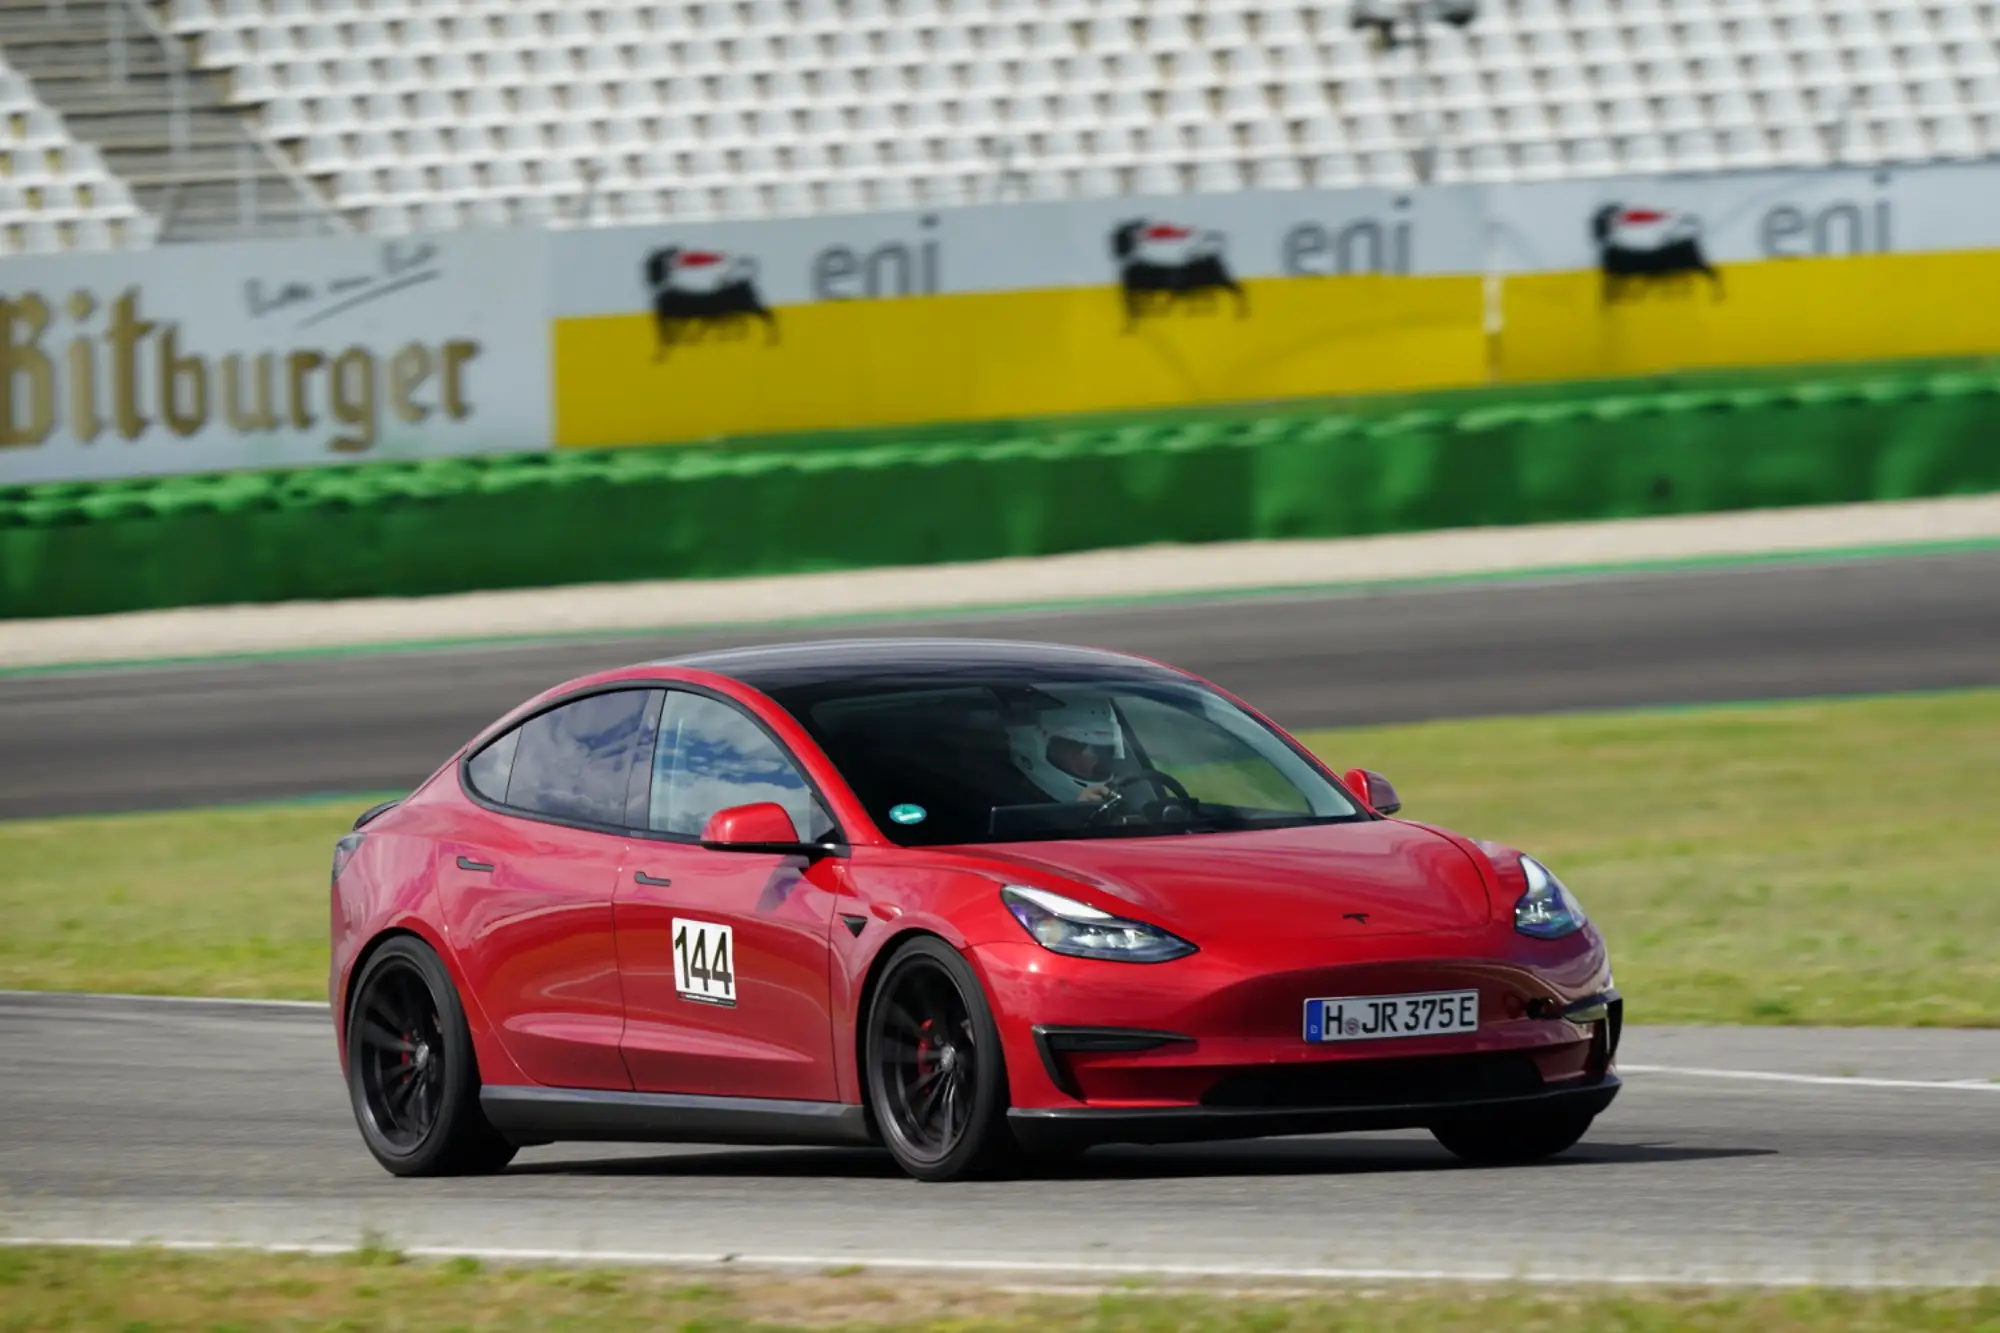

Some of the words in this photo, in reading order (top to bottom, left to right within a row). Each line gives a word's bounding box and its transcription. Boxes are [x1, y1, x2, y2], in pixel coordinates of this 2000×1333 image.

[813, 213, 941, 301] eni
[1283, 195, 1414, 279] eni
[1760, 171, 1891, 260] eni
[0, 284, 480, 453] Bitburger
[674, 925, 733, 996] 144
[1325, 1004, 1343, 1035] H
[1361, 1002, 1398, 1033] JR
